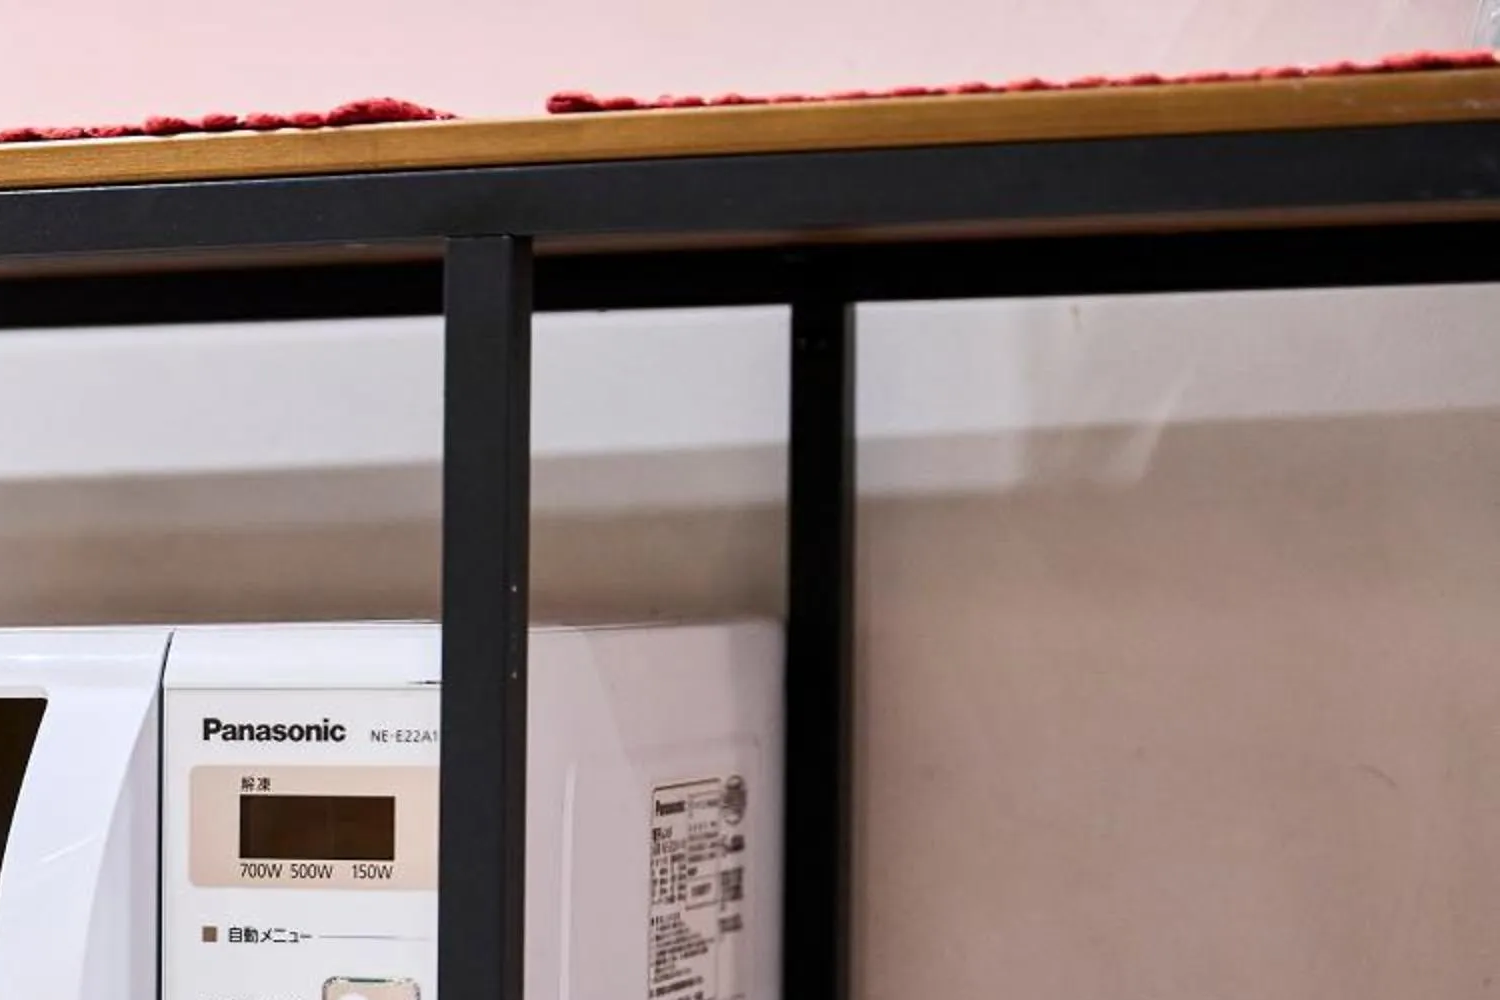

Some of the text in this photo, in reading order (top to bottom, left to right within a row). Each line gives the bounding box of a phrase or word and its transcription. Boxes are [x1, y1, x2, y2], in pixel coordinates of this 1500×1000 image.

[202, 718, 347, 742] Panasonic
[240, 776, 271, 791] 解凍
[240, 863, 394, 880] 700W 500W 150W
[228, 927, 312, 943] 自動メニュー
